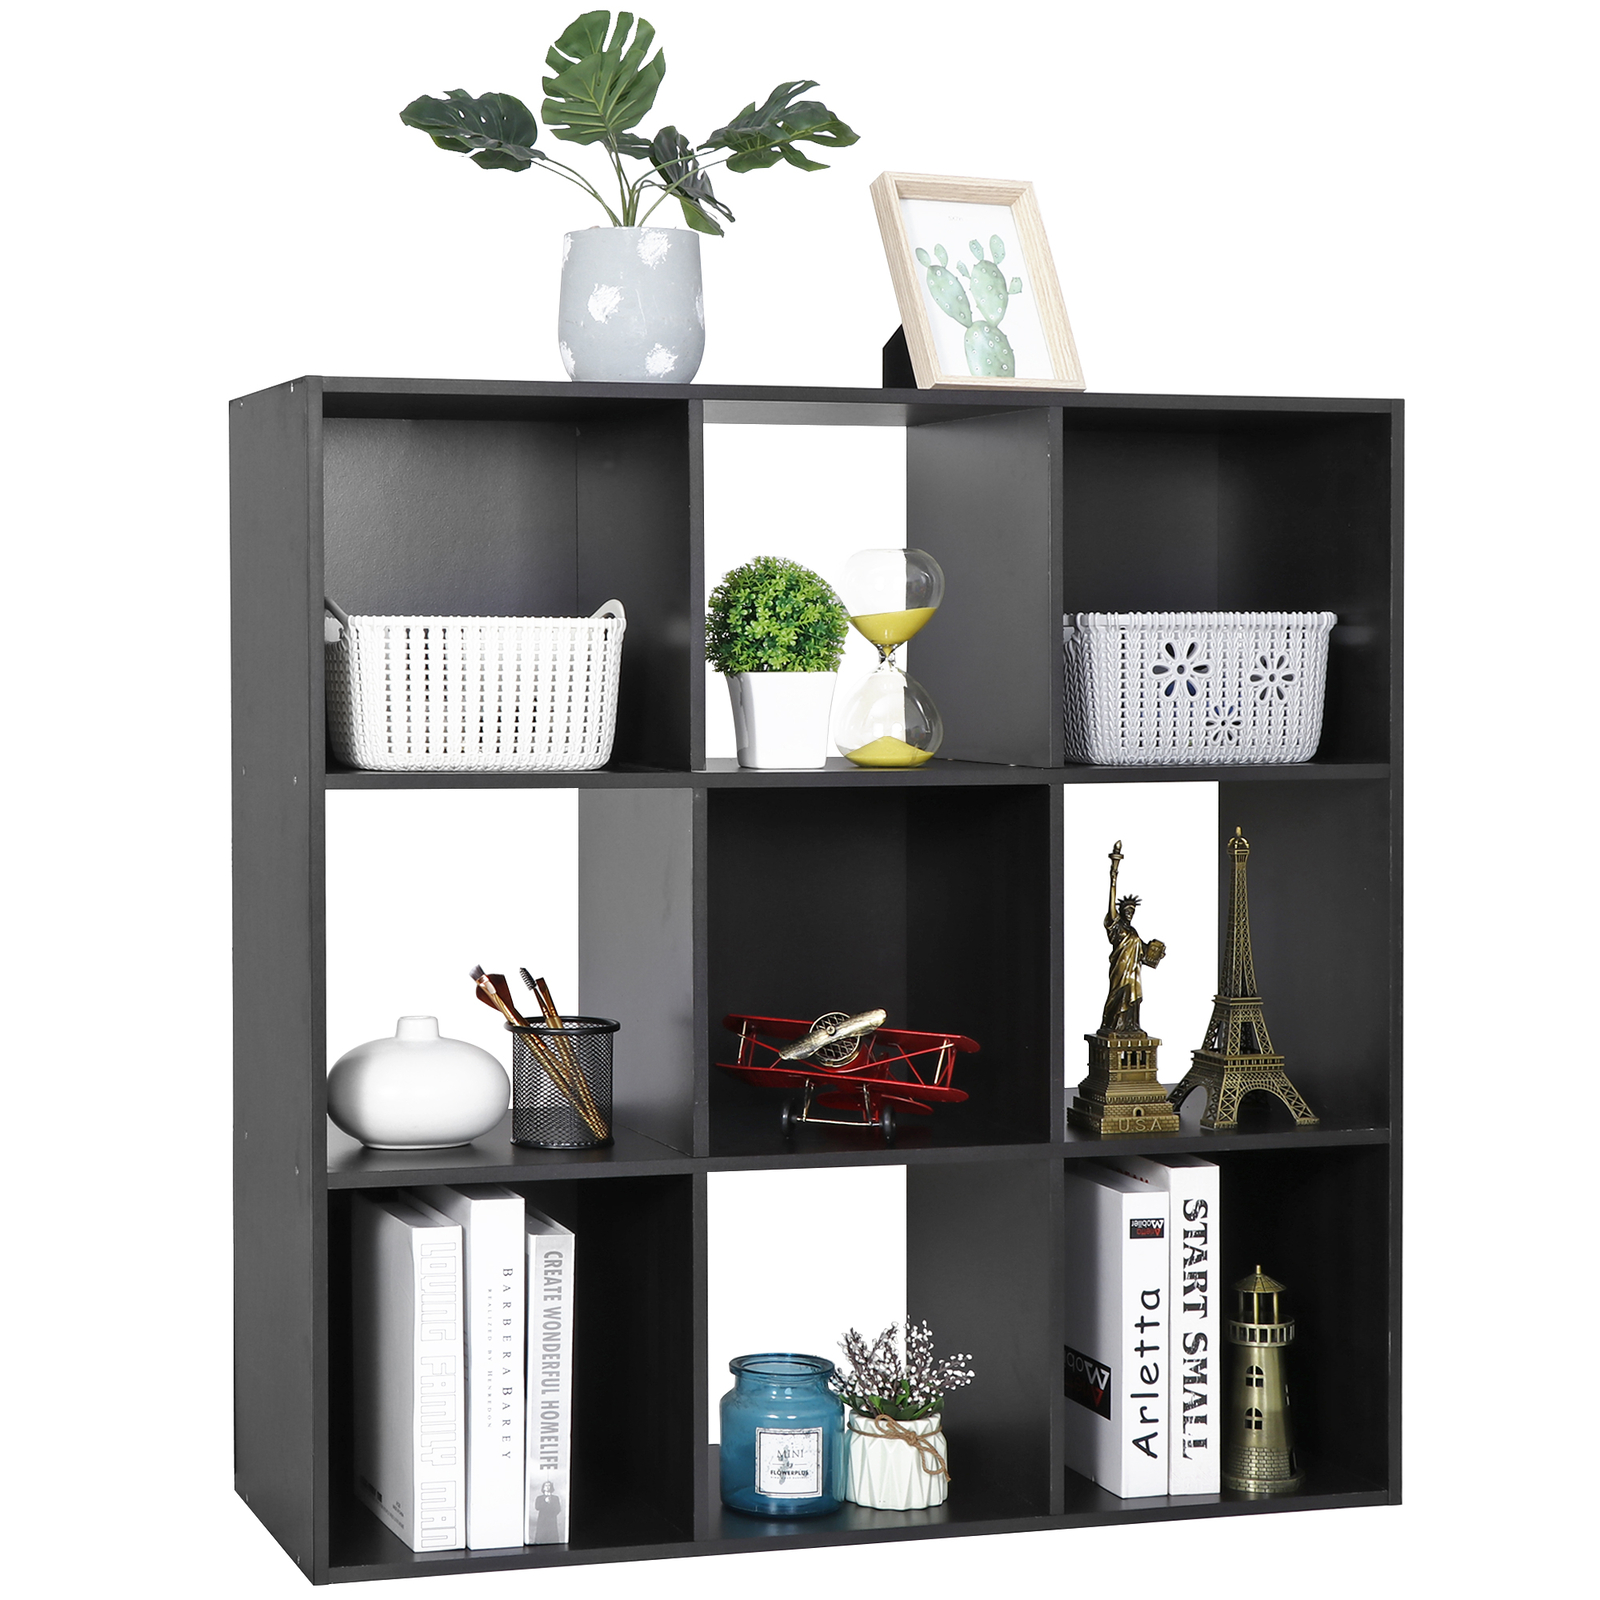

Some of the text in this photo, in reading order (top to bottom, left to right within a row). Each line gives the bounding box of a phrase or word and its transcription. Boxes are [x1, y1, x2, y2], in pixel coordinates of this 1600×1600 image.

[420, 1242, 457, 1548] LOVING FAMILY MAN
[501, 1267, 514, 1459] BARBERA BAREY
[538, 1250, 564, 1471] CREATE WONDERFUL HOMELIFE
[1130, 1287, 1161, 1460] Arletta
[1181, 1198, 1209, 1461] START SMALL
[777, 1449, 804, 1458] MINI
